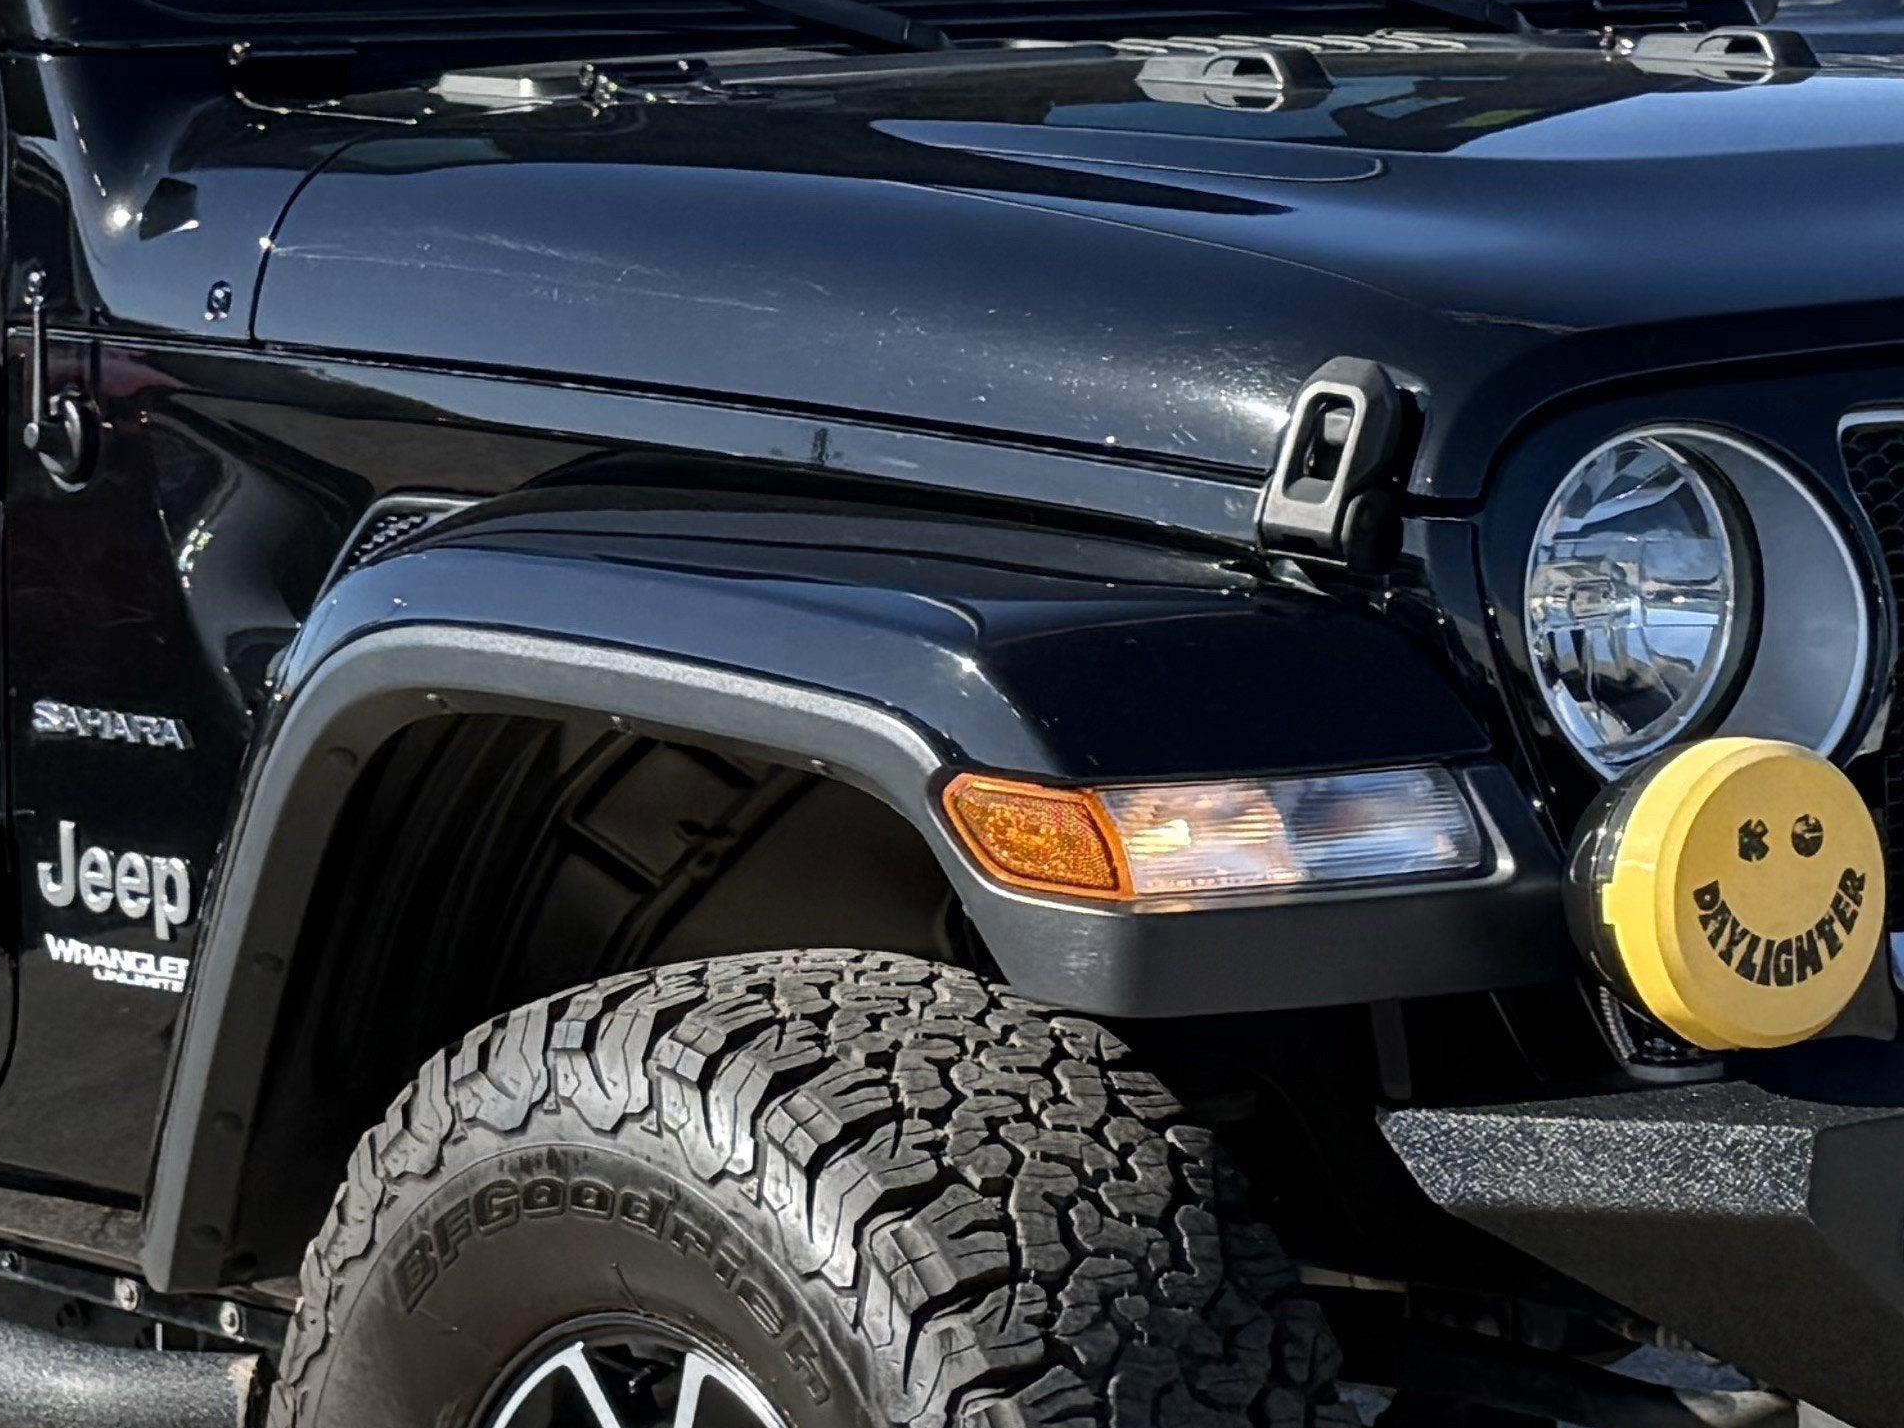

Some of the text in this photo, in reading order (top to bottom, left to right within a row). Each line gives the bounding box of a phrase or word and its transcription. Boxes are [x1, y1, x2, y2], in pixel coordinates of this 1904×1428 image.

[32, 698, 195, 750] SAHARA
[37, 820, 191, 941] Jeep
[1693, 867, 1866, 988] DAYLIGHTER
[388, 1174, 834, 1408] BFGoodrich
